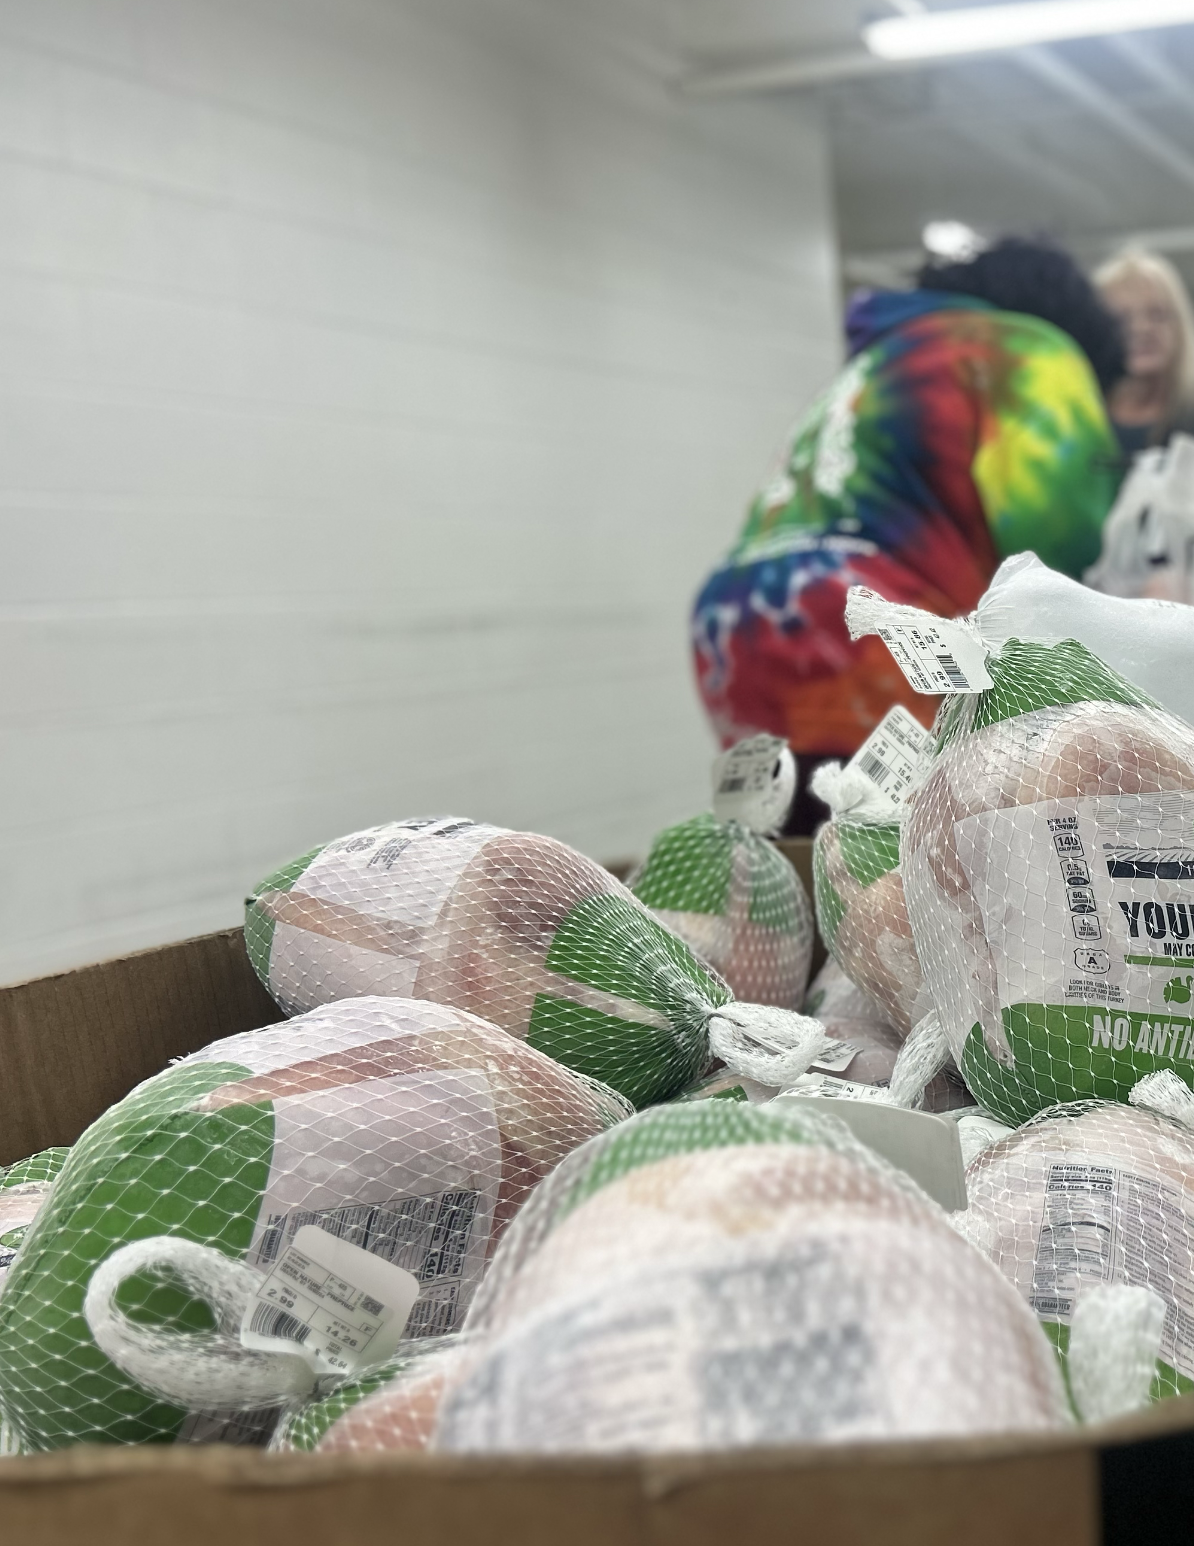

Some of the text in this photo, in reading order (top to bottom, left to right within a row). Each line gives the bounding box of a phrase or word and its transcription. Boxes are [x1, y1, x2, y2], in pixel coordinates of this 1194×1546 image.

[936, 670, 951, 688] 2.99
[871, 742, 886, 757] 2.99
[1058, 836, 1078, 846] 140
[1164, 943, 1183, 956] MAY
[1088, 957, 1097, 965] A
[1091, 1014, 1130, 1051] NO
[1090, 1166, 1113, 1175] Facts
[425, 1193, 453, 1279] Calories 140
[283, 1262, 299, 1275] OPEN
[267, 1288, 295, 1309] 2.99
[326, 1326, 358, 1347] 14.26
